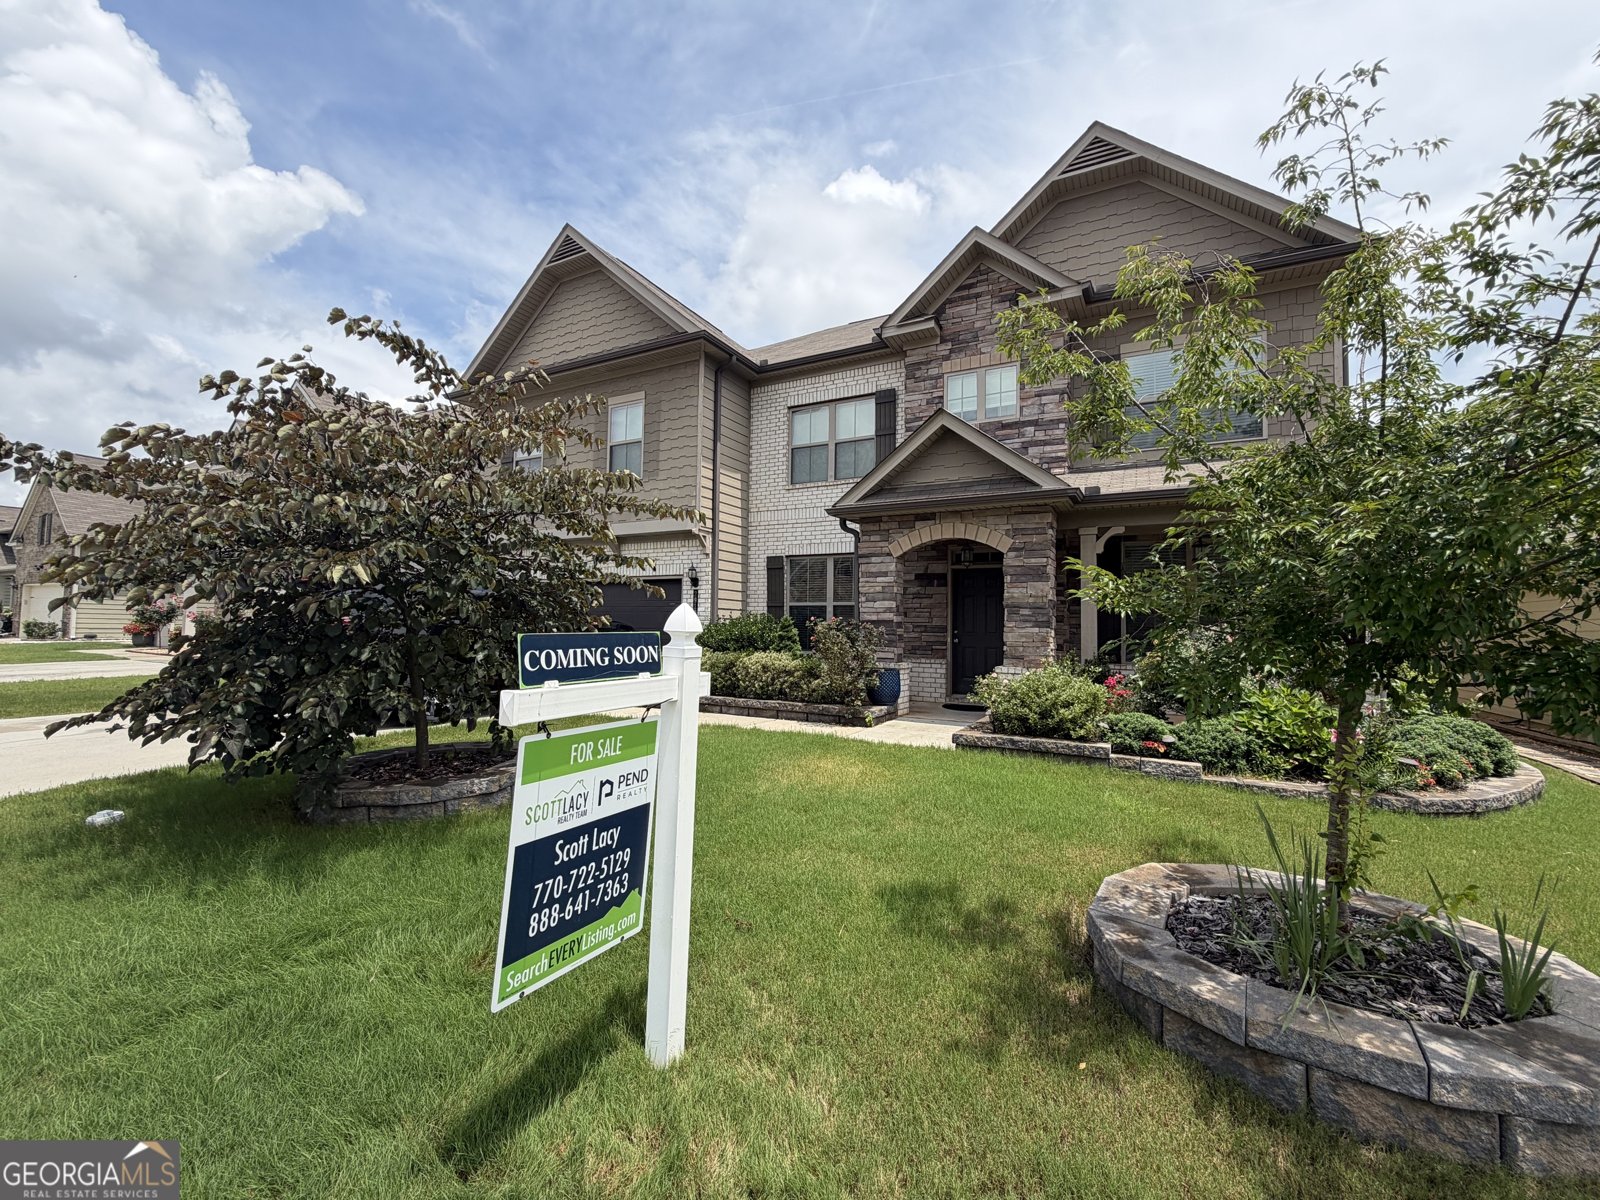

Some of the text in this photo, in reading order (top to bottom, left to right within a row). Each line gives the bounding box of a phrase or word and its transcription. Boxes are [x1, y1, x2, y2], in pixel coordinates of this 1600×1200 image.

[524, 645, 658, 672] COMING SOON
[570, 736, 622, 765] FOR SALE
[618, 768, 648, 788] PEND
[617, 786, 647, 800] REALTY
[558, 809, 587, 824] REALTY TEAM
[554, 825, 621, 866] Scott Lacy
[532, 848, 631, 908] 770-722-5129
[528, 873, 628, 938] 888-641-7363
[506, 912, 636, 992] SearchEVERYListing.com
